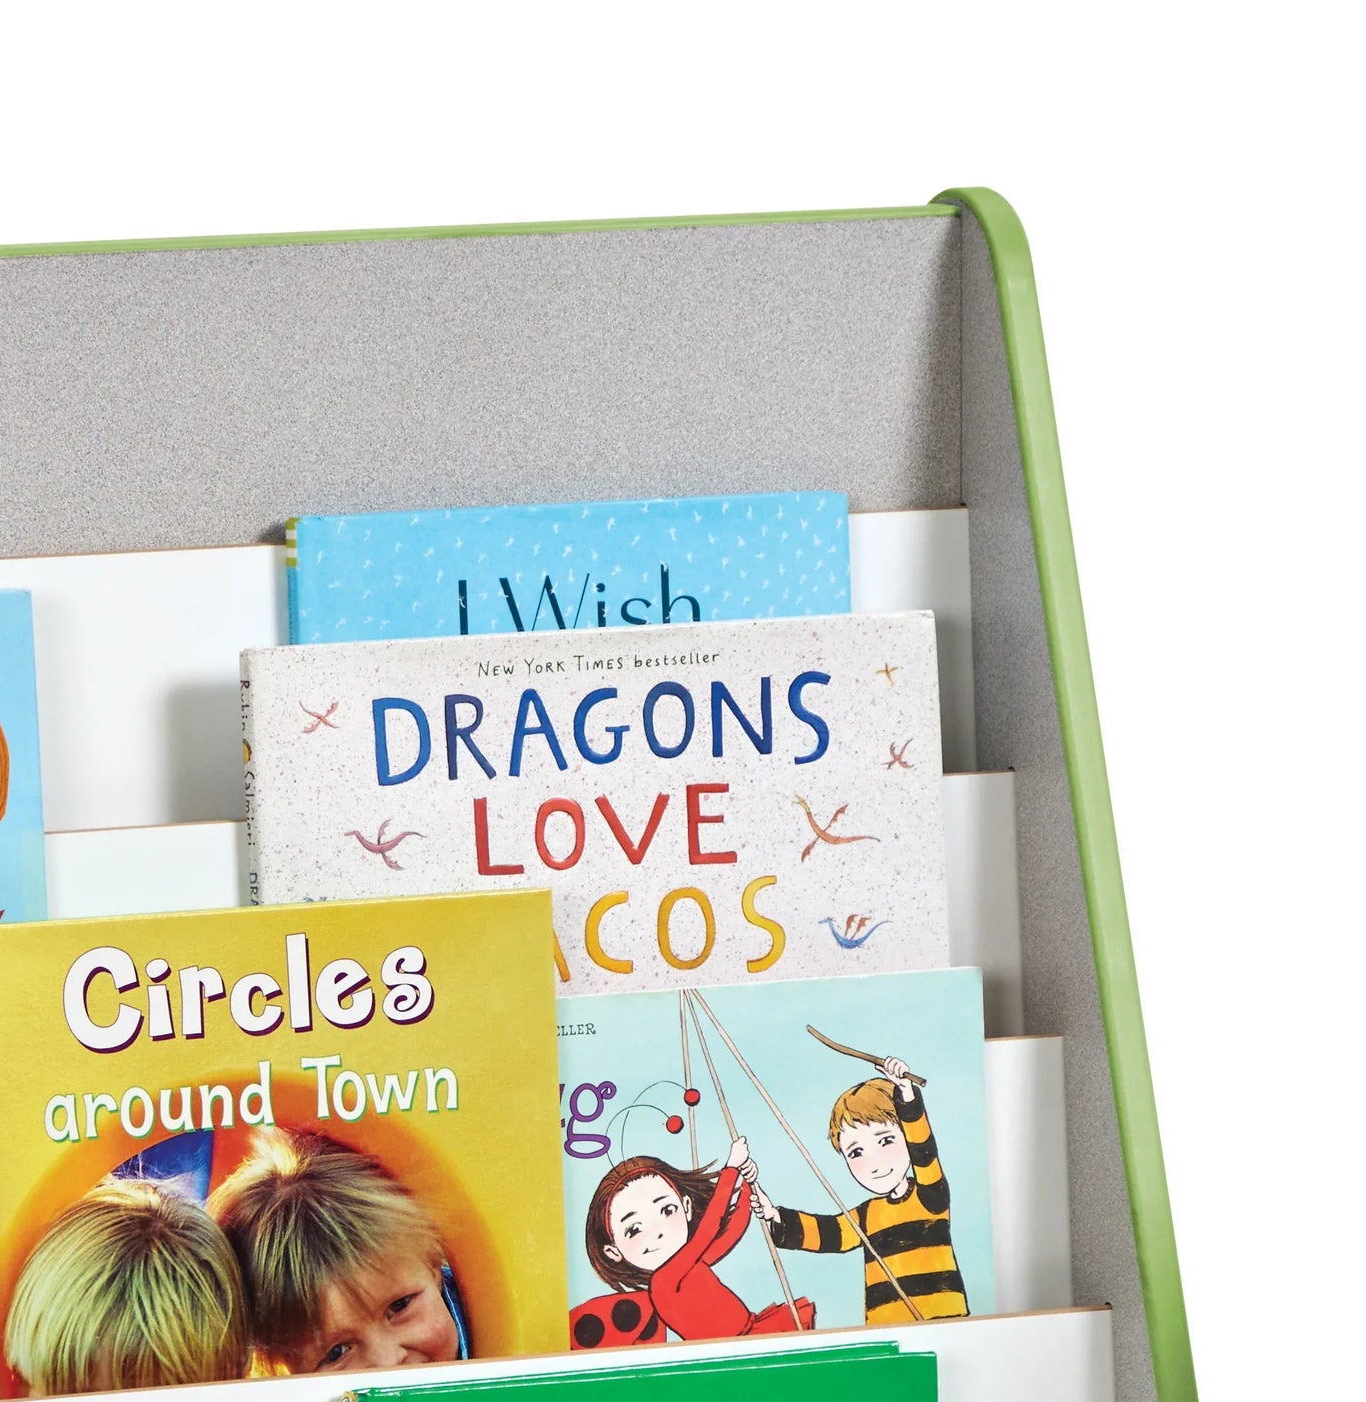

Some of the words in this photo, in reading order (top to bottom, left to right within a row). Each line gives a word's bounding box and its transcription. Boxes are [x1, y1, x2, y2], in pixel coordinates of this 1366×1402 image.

[458, 579, 469, 635] I
[499, 562, 701, 632] Wish
[634, 652, 720, 668] bestseller
[371, 671, 832, 787] DRAGONS
[473, 783, 738, 876] LOVE
[555, 875, 786, 983] COS
[62, 932, 435, 1054] Circles
[42, 1061, 275, 1145] around
[300, 1054, 459, 1126] Town
